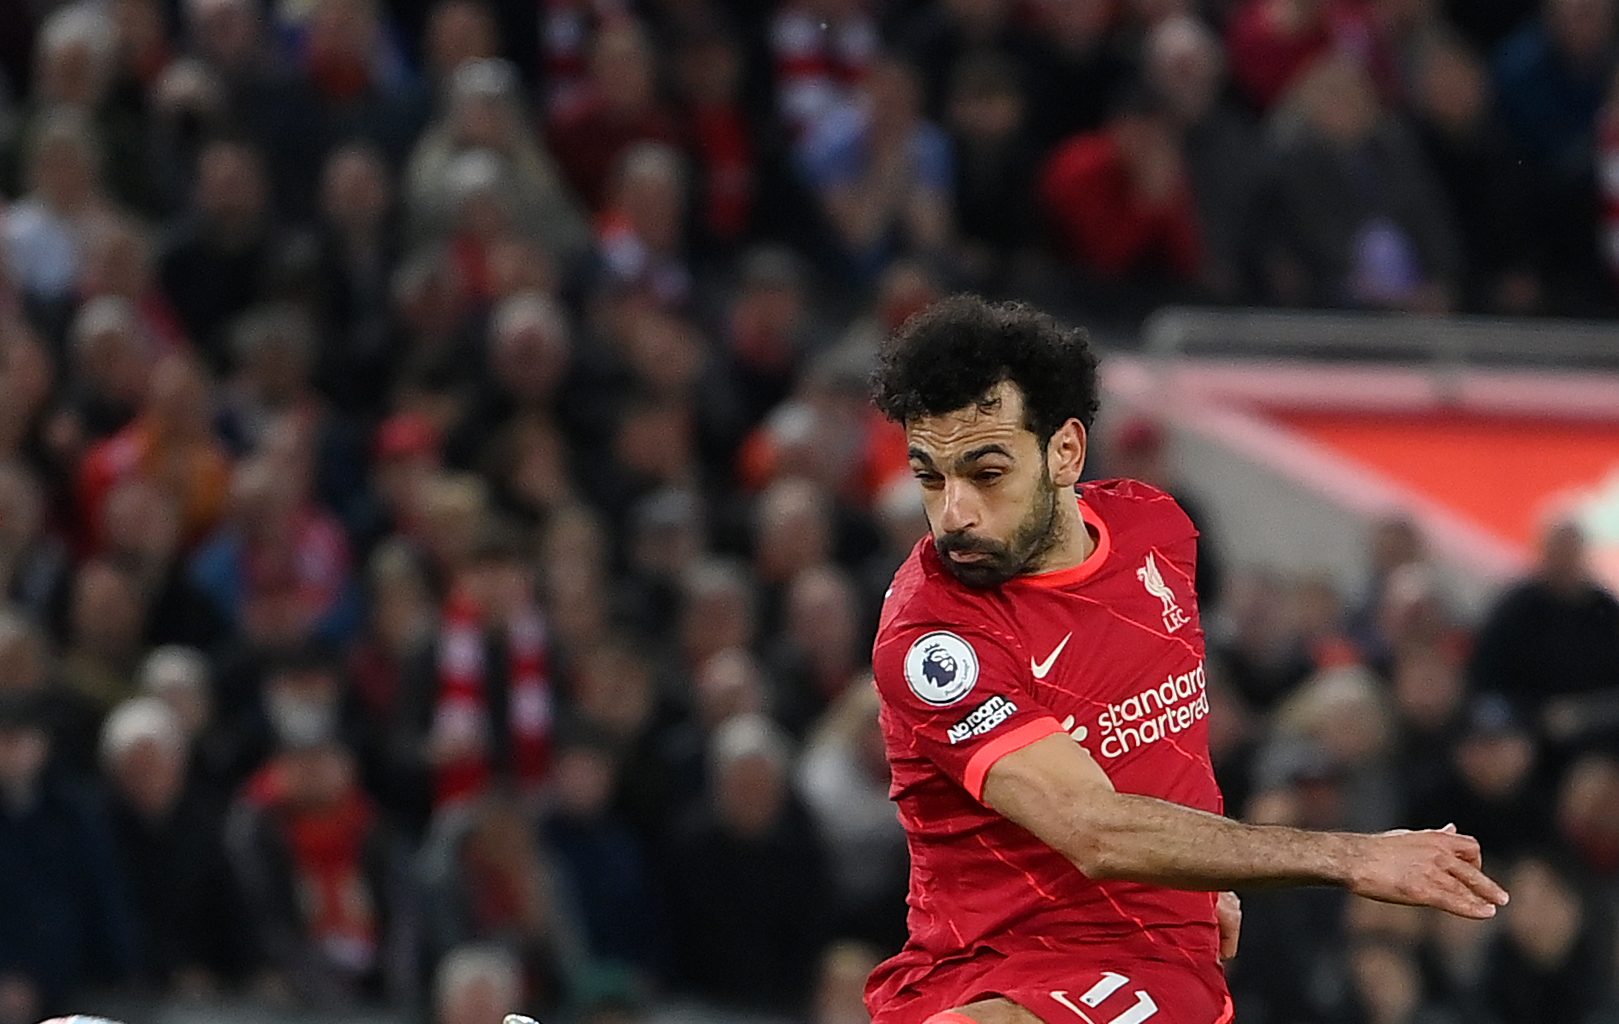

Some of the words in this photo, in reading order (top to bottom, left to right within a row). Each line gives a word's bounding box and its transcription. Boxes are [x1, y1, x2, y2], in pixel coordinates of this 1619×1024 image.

[946, 722, 969, 744] No
[966, 695, 1004, 727] room
[1098, 659, 1206, 736] standard
[1100, 688, 1209, 758] chartered
